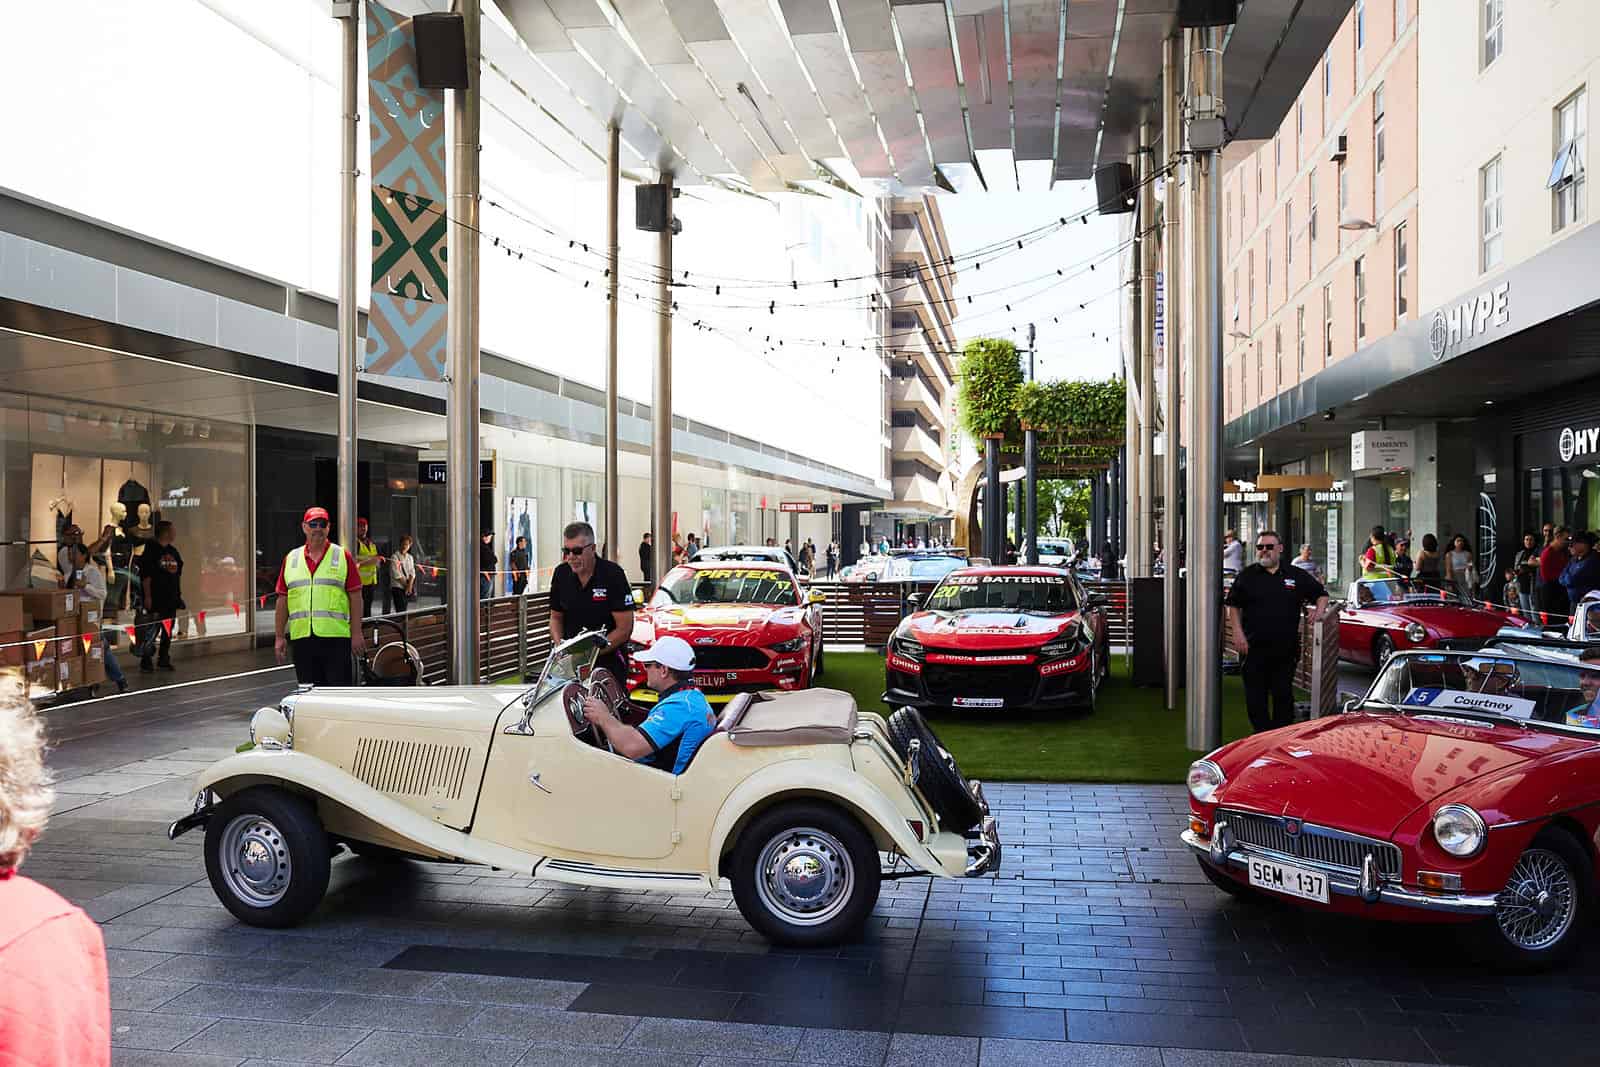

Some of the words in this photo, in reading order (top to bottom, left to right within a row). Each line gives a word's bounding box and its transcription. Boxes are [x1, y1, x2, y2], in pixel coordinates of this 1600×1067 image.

[1447, 280, 1511, 346] HYPE
[1575, 427, 1600, 455] HY
[694, 569, 778, 580] PIRTEK
[982, 576, 1065, 585] BATTERIES
[933, 584, 961, 598] 20
[1051, 659, 1077, 671] HINO
[693, 676, 725, 688] HELLVP
[1417, 691, 1429, 702] 5
[1454, 695, 1513, 712] Courtney
[1253, 861, 1284, 886] SEM
[1296, 872, 1323, 895] 137
